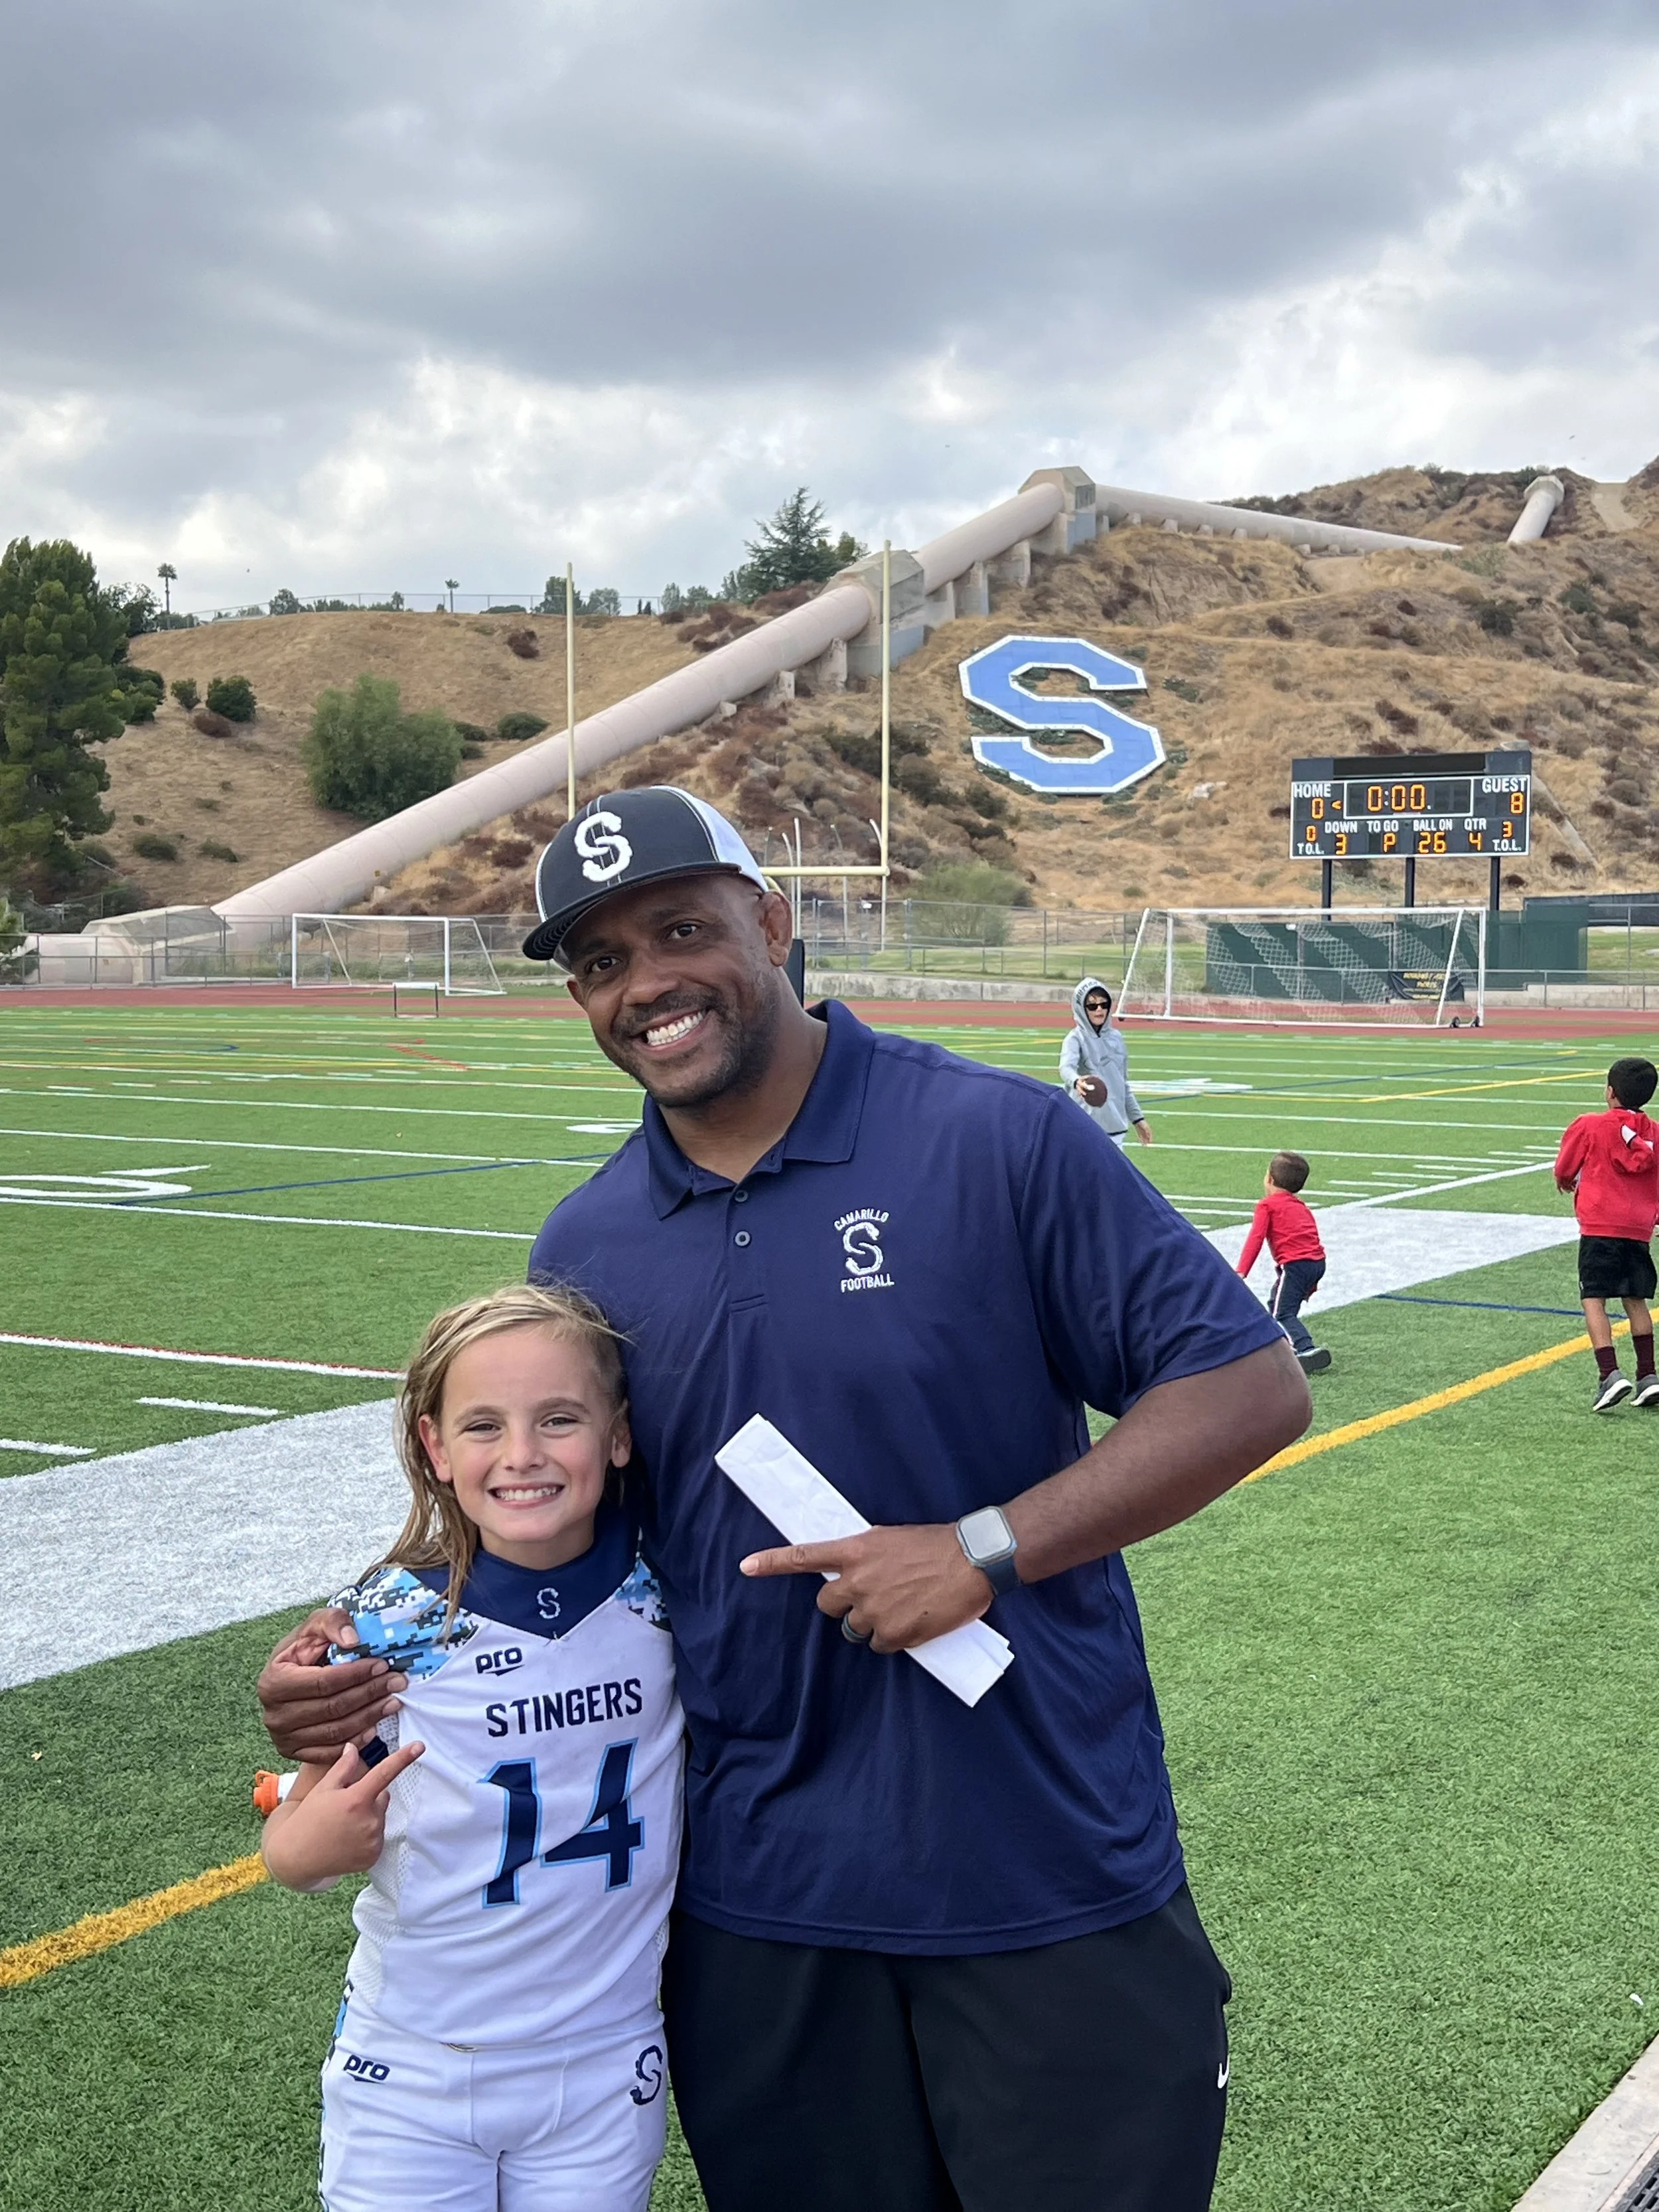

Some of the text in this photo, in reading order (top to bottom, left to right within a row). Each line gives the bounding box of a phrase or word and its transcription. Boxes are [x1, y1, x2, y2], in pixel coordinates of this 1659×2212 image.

[958, 635, 1167, 793] S
[1294, 783, 1331, 798] HOME
[1482, 777, 1526, 793] GUEST
[1311, 798, 1324, 819] 0
[1510, 792, 1524, 814] 8
[1306, 826, 1316, 842] 0
[1325, 821, 1358, 834] DOWN
[1366, 820, 1399, 834] TO GO
[1413, 818, 1453, 832] BALL ON
[1464, 818, 1487, 831] QTR
[1502, 821, 1512, 838] 3
[573, 811, 633, 883] S
[1336, 833, 1346, 855] 3
[1417, 831, 1447, 853] 26
[1469, 832, 1482, 851] 4
[834, 1209, 889, 1230] CAMARILLO
[843, 1222, 883, 1275] S
[841, 1274, 895, 1293] FOOTBALL
[536, 1587, 561, 1619] S
[474, 1647, 524, 1674] pro
[485, 1677, 643, 1738] STINGERS
[476, 1737, 645, 1909] 14
[343, 2055, 391, 2081] pro
